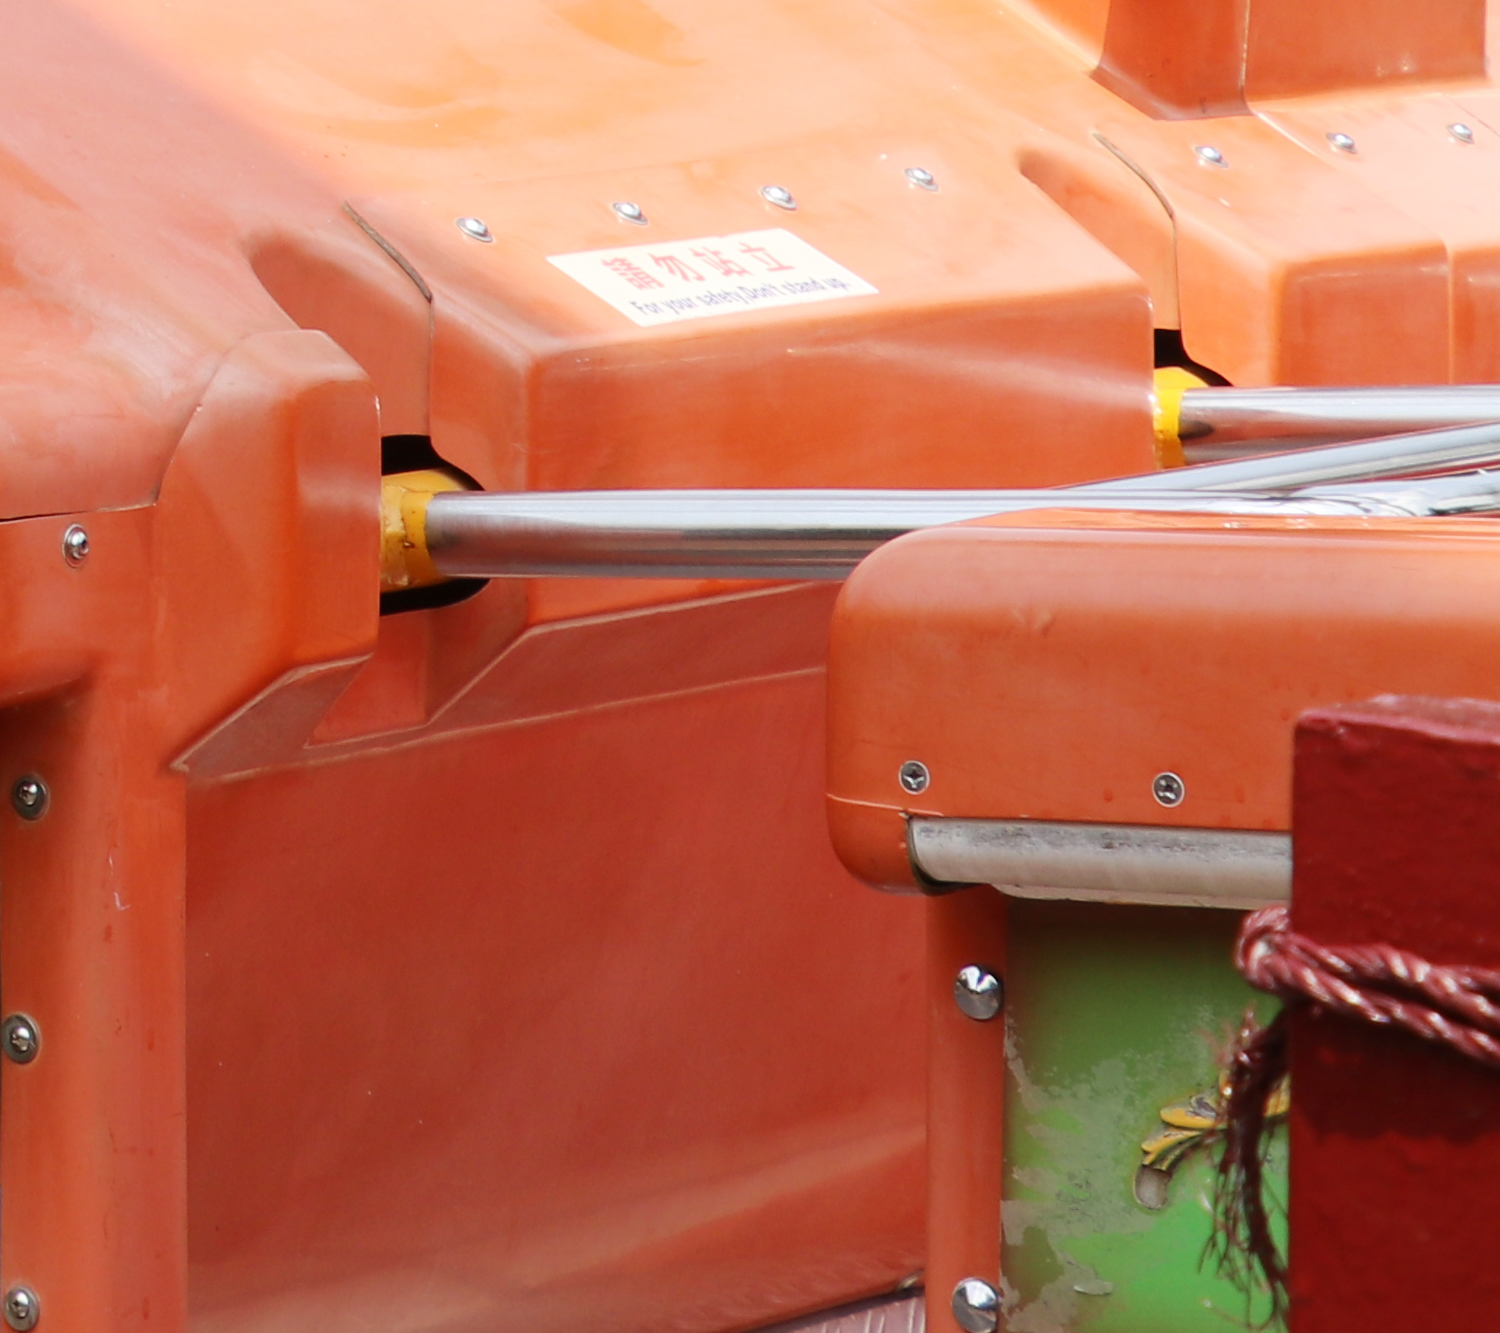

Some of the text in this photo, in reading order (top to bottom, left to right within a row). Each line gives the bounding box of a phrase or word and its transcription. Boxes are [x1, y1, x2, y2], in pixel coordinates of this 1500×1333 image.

[601, 241, 795, 290] 請勿站立
[630, 300, 660, 316] For
[661, 296, 698, 316] your
[781, 277, 824, 296] stand
